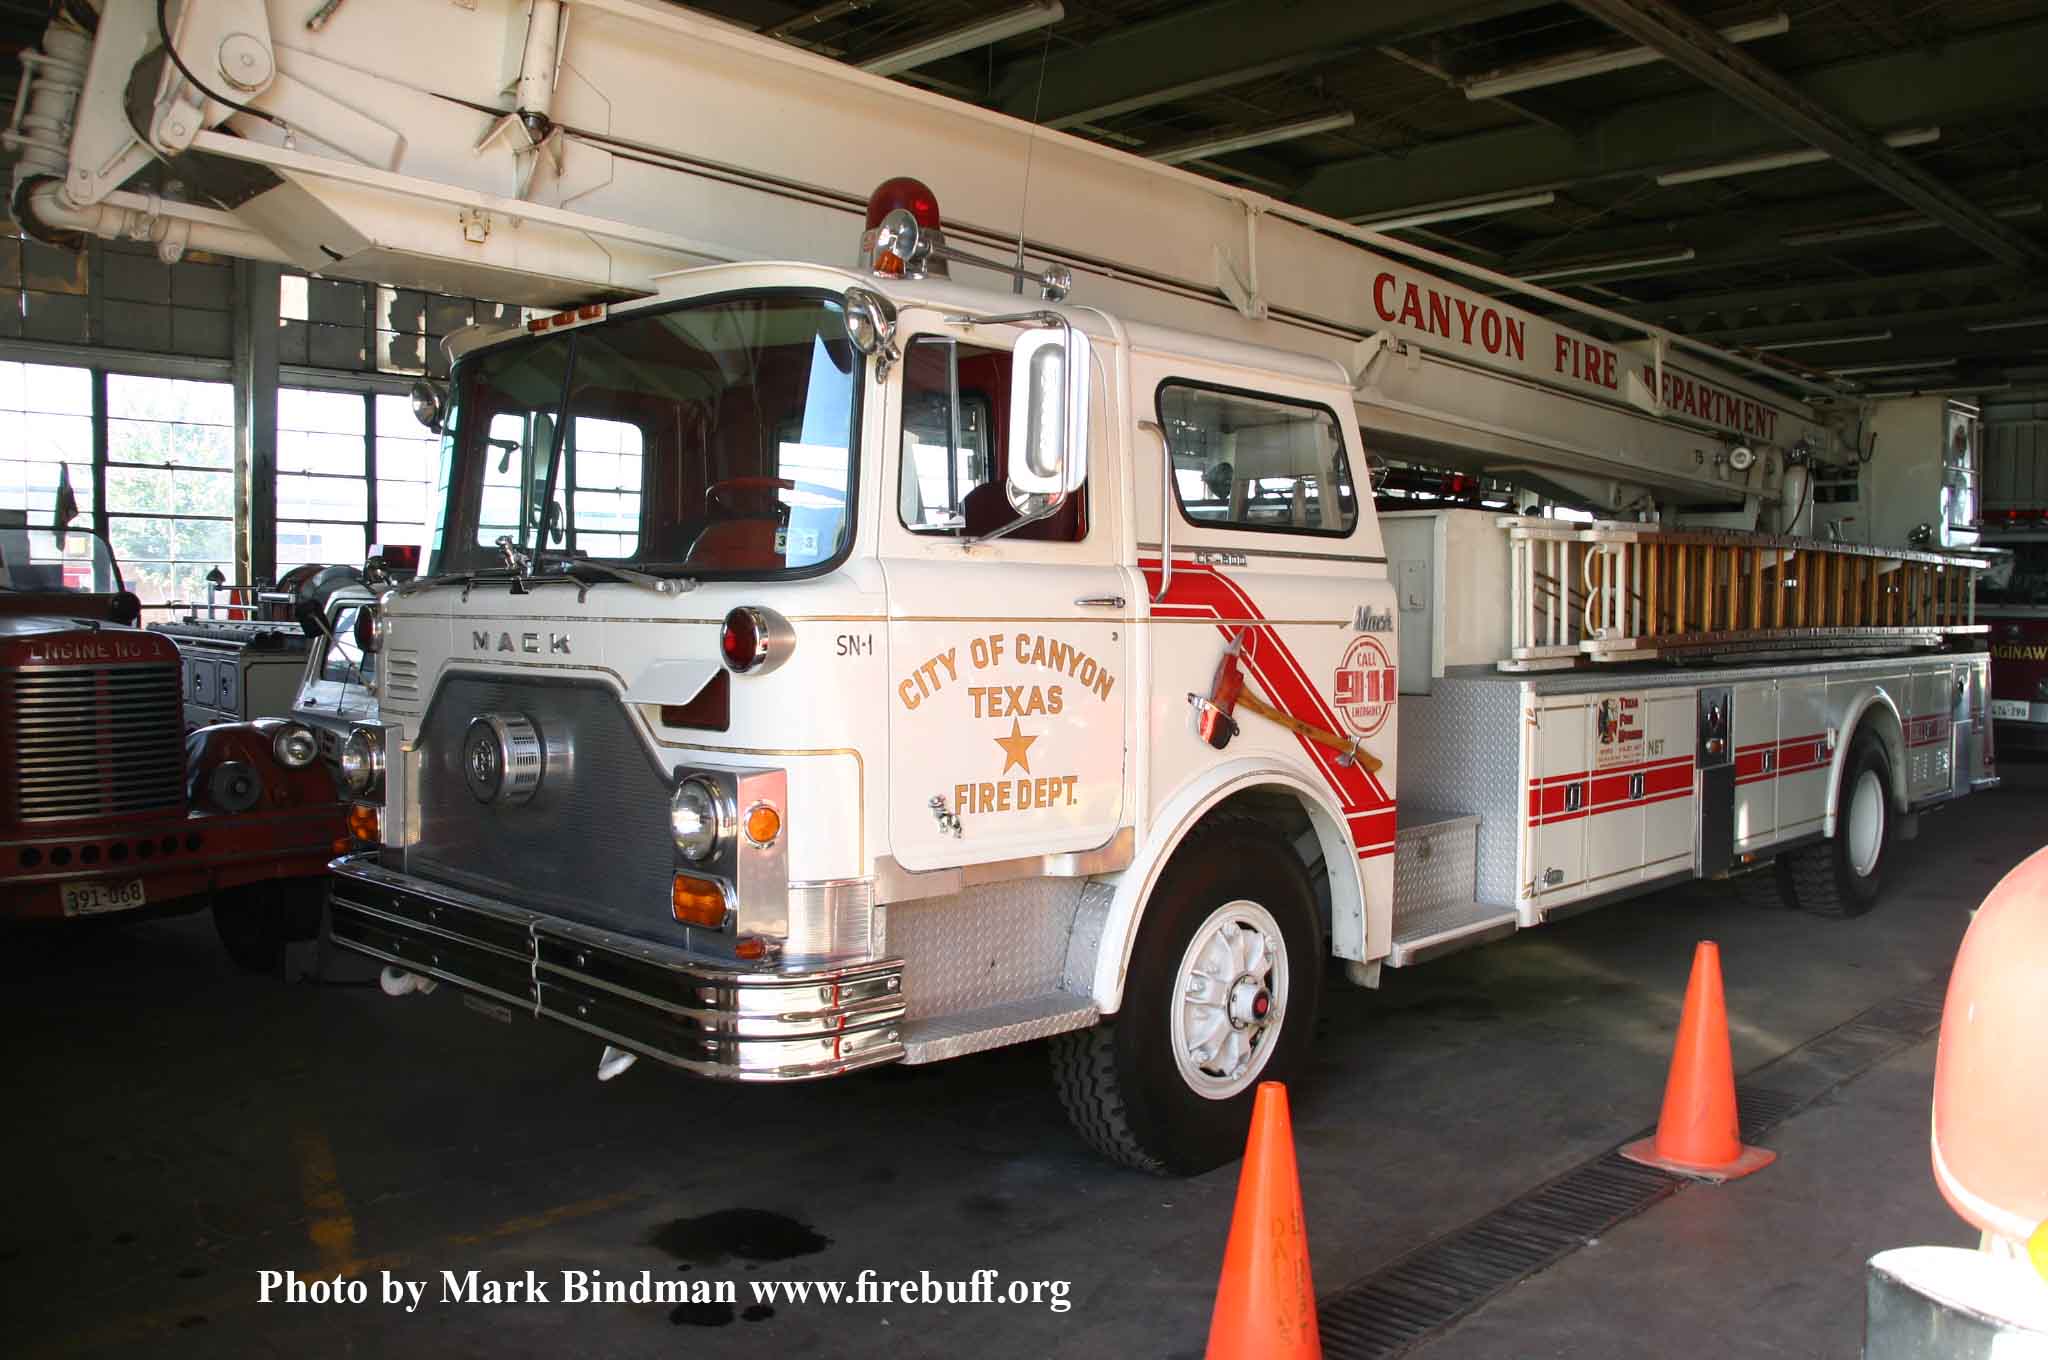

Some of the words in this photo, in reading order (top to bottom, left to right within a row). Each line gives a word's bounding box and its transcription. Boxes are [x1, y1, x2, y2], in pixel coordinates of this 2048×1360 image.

[1373, 272, 1525, 361] CANYON
[1554, 334, 1618, 391] FIRE
[30, 641, 110, 660] ENGINE
[472, 631, 571, 654] MACK
[898, 648, 957, 710] CITY
[970, 634, 1004, 669] OF
[1015, 633, 1115, 701] CANYON
[1357, 652, 1376, 667] CALL
[967, 685, 1063, 718] TEXAS
[1335, 669, 1395, 704] 911
[1648, 739, 1664, 756] NET
[954, 781, 1012, 816] FIRE
[1017, 775, 1079, 810] DEPT.
